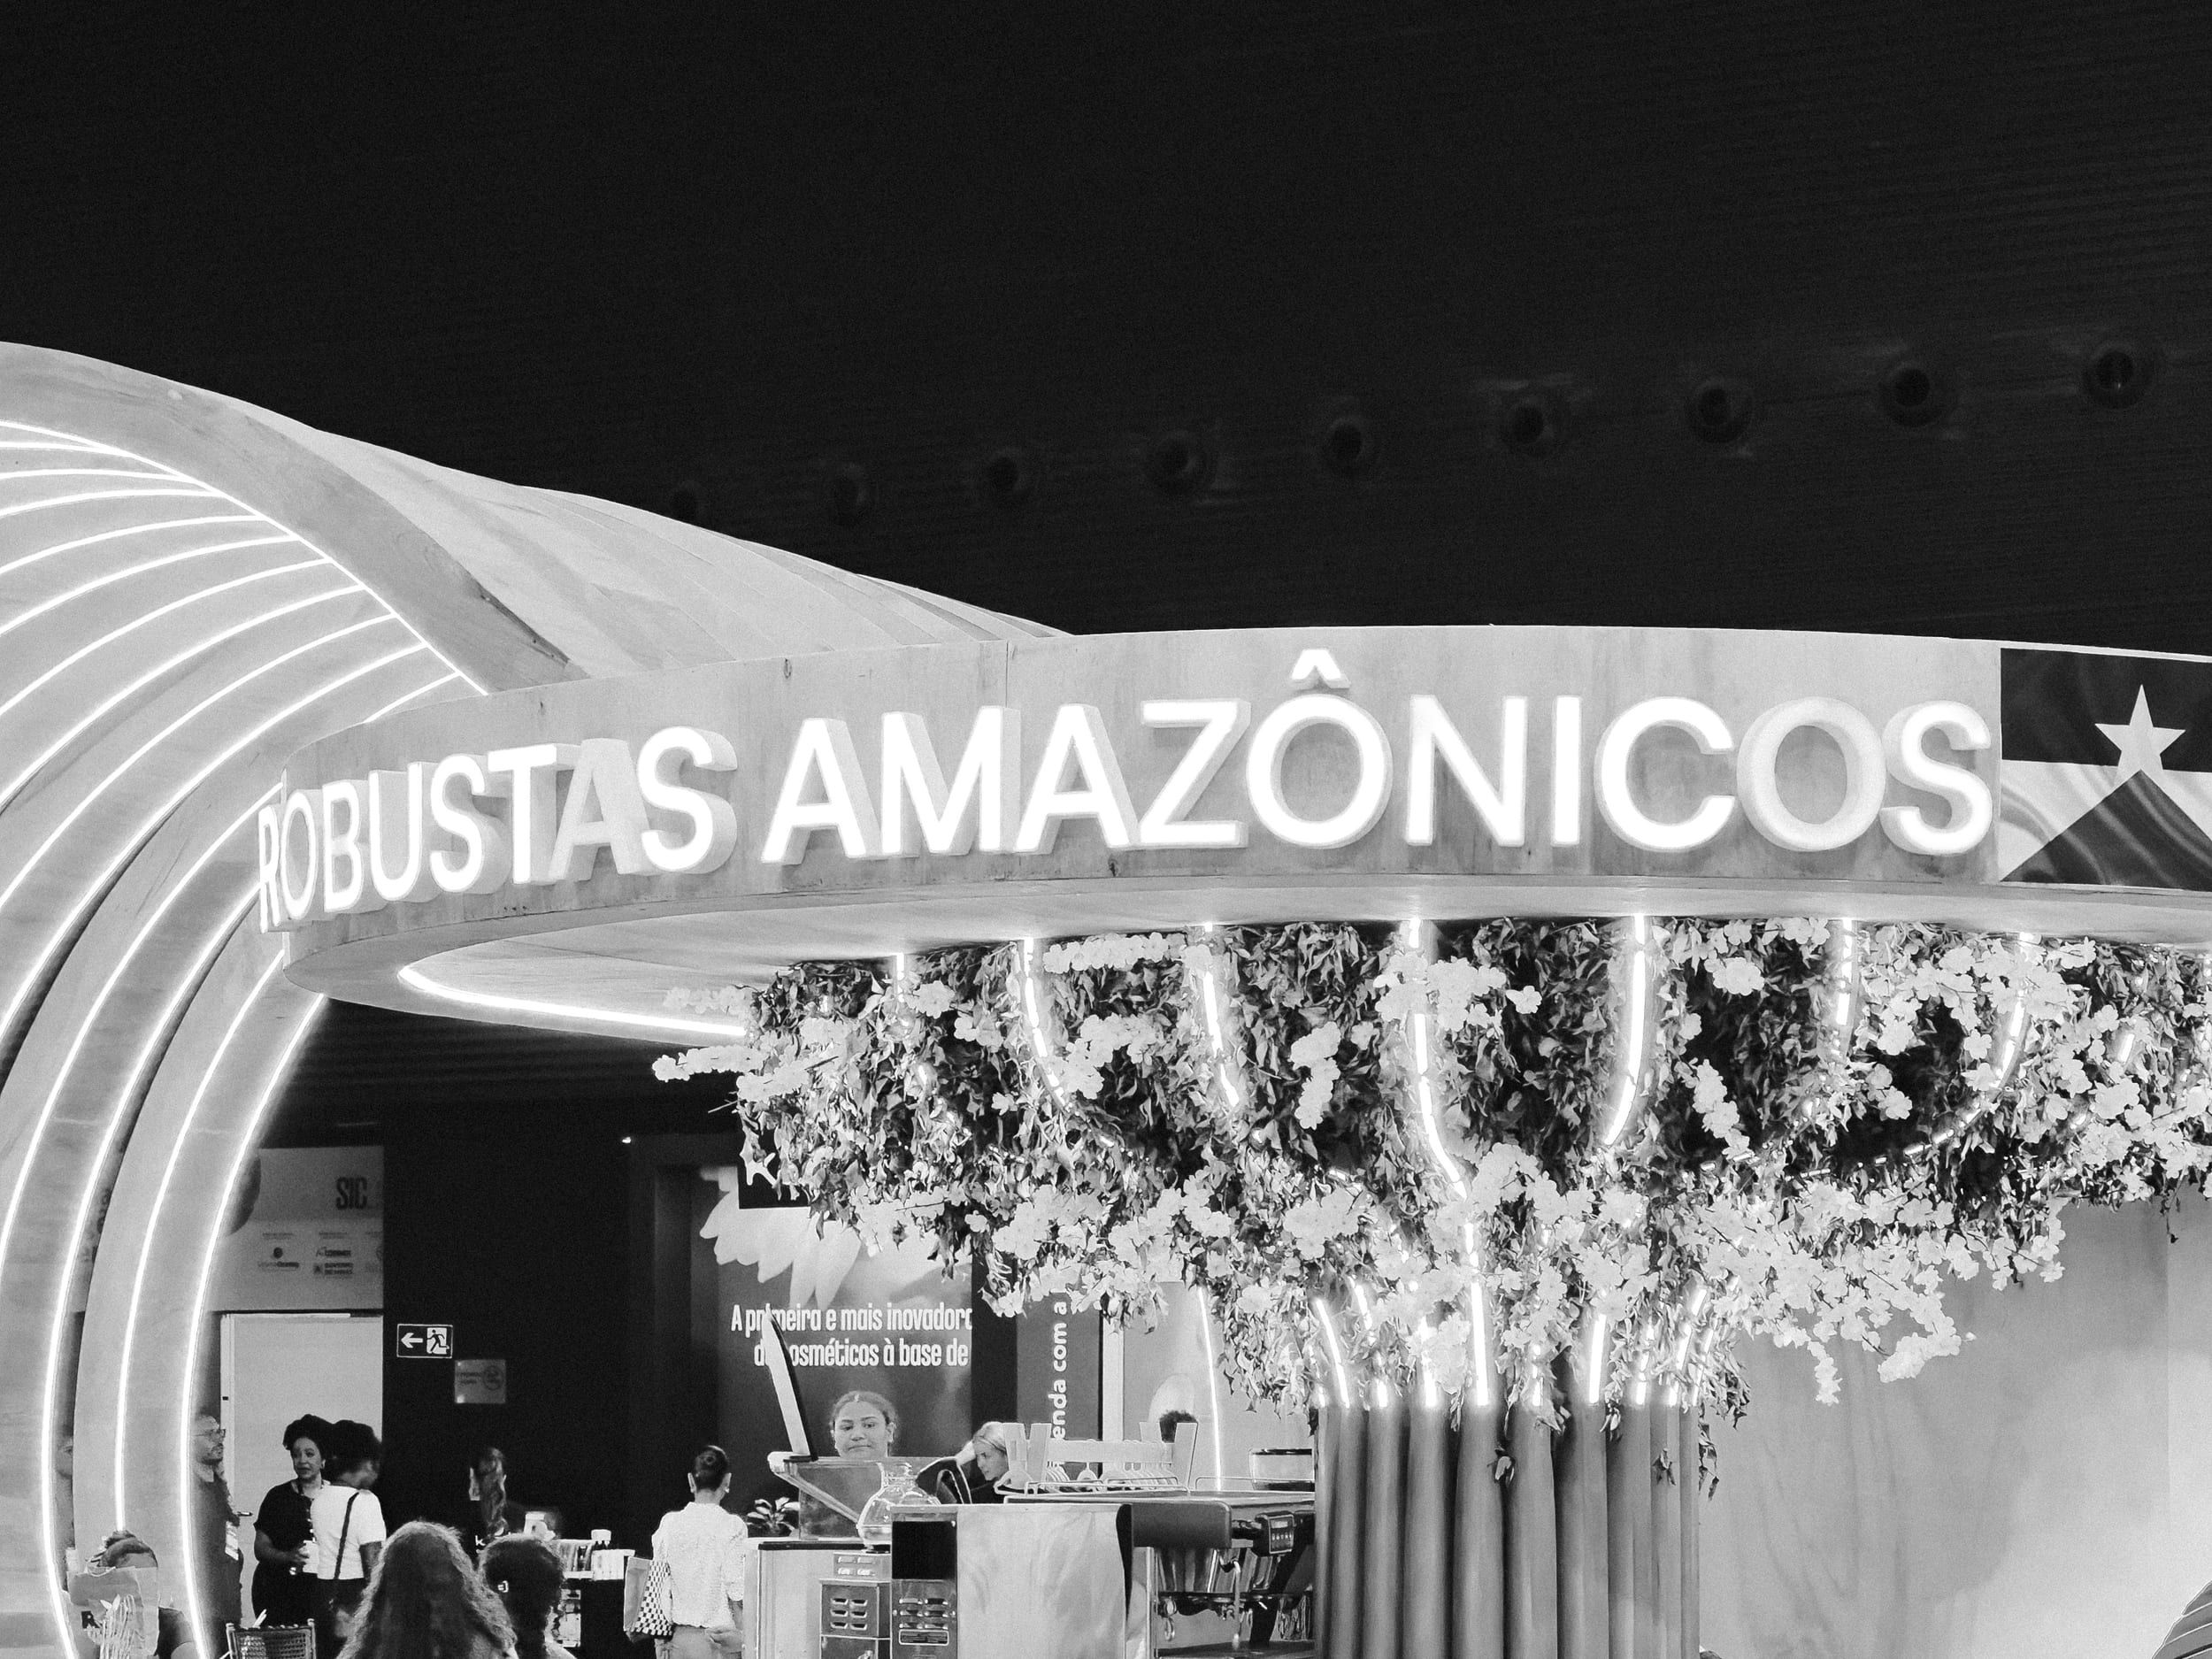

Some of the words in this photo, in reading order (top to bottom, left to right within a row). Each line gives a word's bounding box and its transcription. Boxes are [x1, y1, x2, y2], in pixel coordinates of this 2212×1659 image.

[258, 725, 739, 933] ROBUSTAS
[761, 647, 1994, 857] AMAZÔNICOS
[335, 1176, 368, 1210] SIC
[731, 1303, 743, 1332] A
[826, 1308, 837, 1331] e
[841, 1302, 883, 1331] mais
[1053, 1301, 1067, 1316] a
[790, 1337, 879, 1367] osméticos
[883, 1337, 895, 1366] à
[899, 1337, 941, 1366] base
[946, 1337, 969, 1366] de
[1053, 1322, 1067, 1372] com
